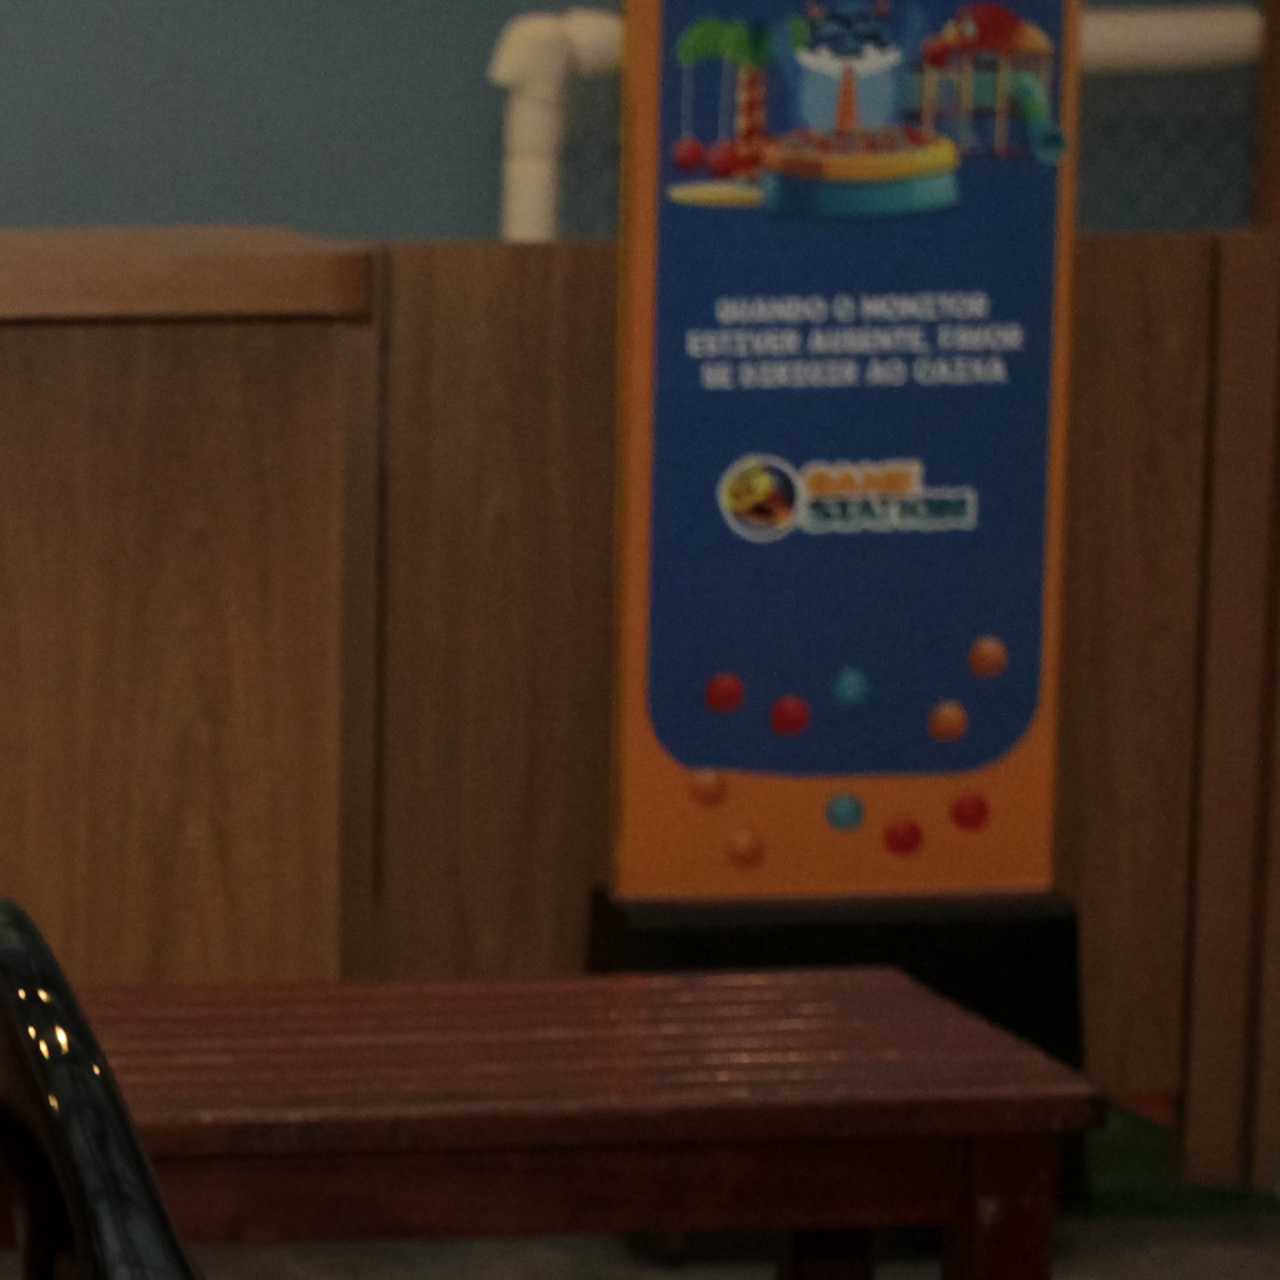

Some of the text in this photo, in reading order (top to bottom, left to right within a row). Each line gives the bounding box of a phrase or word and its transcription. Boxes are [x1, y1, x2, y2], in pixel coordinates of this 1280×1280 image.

[861, 291, 989, 321] MONITOR
[866, 358, 907, 387] AO
[913, 356, 1008, 385] CAIXA
